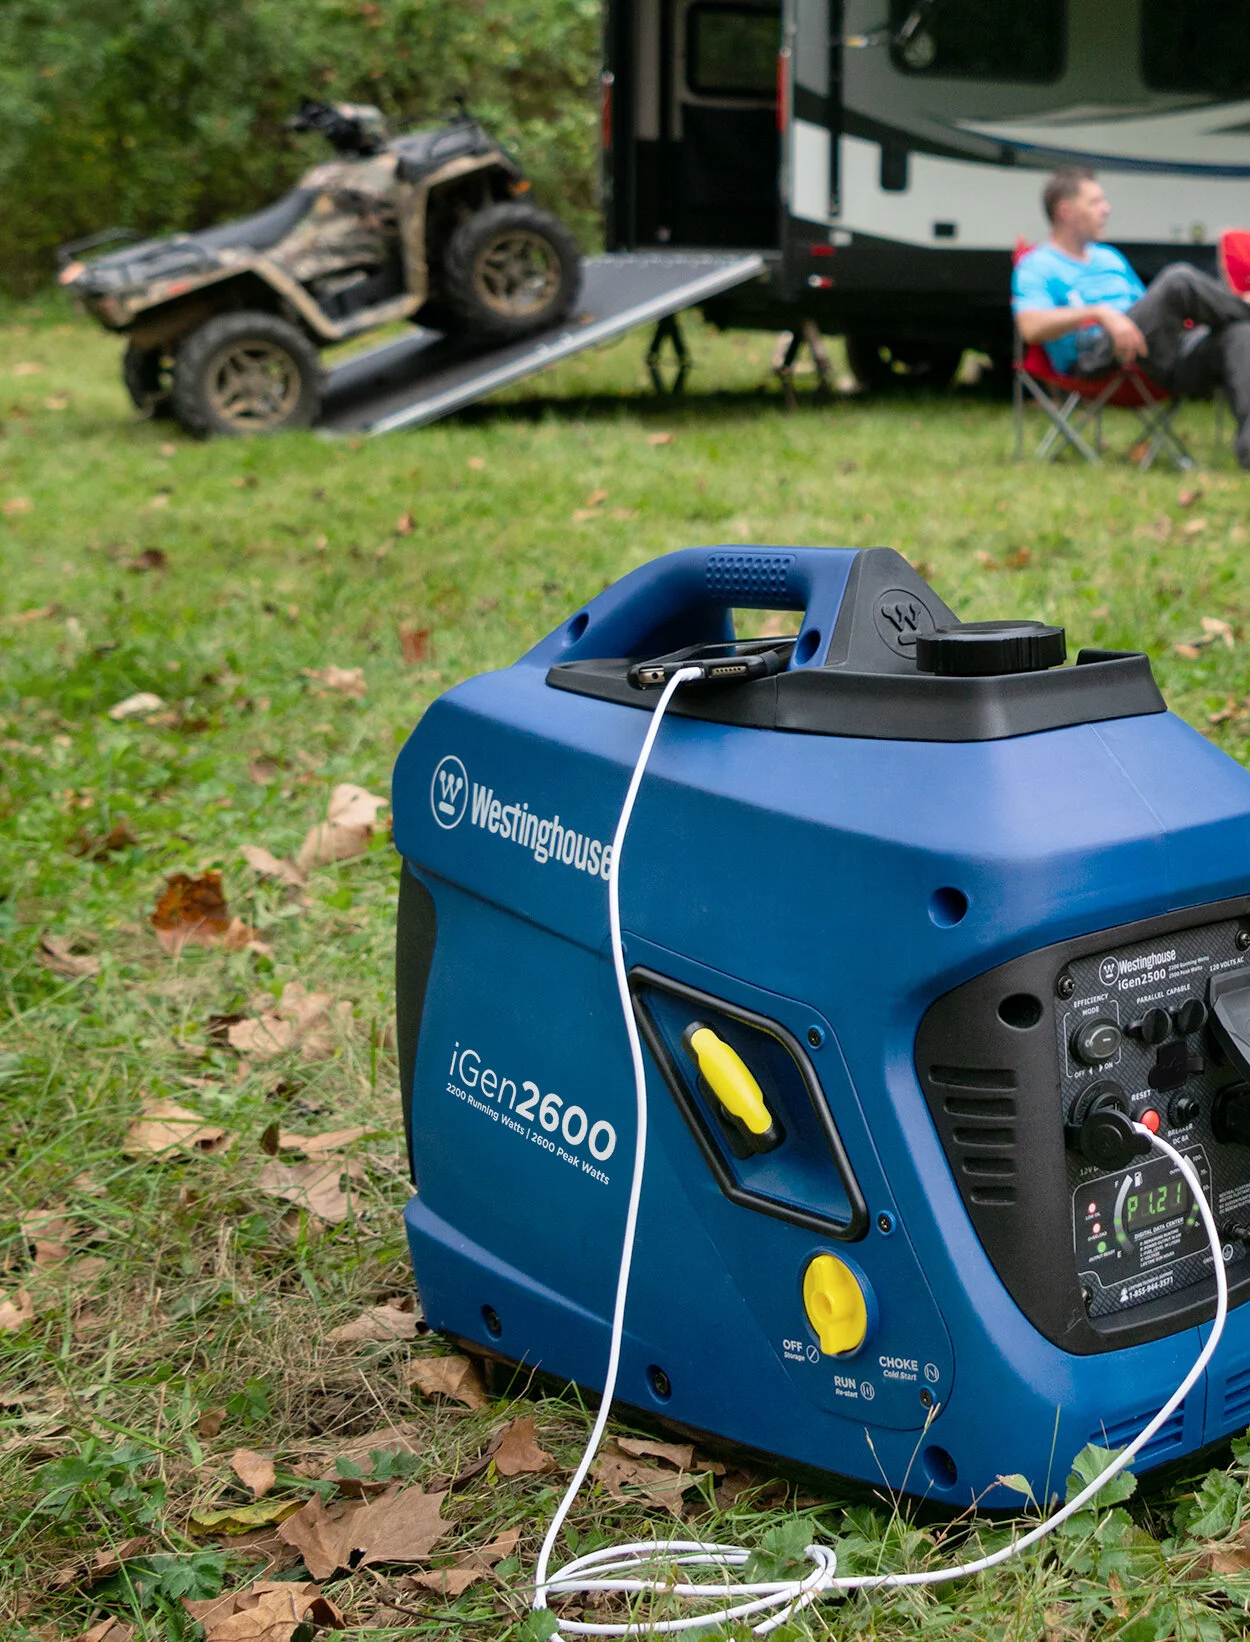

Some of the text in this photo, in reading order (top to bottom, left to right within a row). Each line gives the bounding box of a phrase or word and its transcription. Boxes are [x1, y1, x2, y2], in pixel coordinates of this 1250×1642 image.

[471, 782, 614, 881] Westinghouse
[1118, 949, 1177, 975] Westinghouse
[1209, 956, 1244, 972] 120 VOLTS AC
[1118, 969, 1166, 990] iGen2500
[1073, 993, 1109, 1008] EFFICIENCY
[1136, 983, 1191, 1004] PARALLEL CAPABLE
[1082, 1006, 1099, 1016] MODE
[1074, 1062, 1114, 1079] OFF ON
[449, 1041, 617, 1161] iGen2600
[1131, 1089, 1151, 1102] RESET
[446, 1083, 466, 1101] 2200
[467, 1094, 499, 1122] Running
[501, 1113, 525, 1136] Watts
[530, 1132, 555, 1153] 2600
[556, 1147, 579, 1168] Peak
[581, 1160, 610, 1186] Watts
[1114, 1180, 1119, 1188] F
[1134, 1216, 1184, 1240] DIGITAL DATA CENTER
[1117, 1250, 1122, 1258] E
[1129, 1275, 1174, 1300] 1-855-944-3571
[782, 1339, 802, 1352] OFF
[784, 1351, 806, 1363] Storage
[879, 1356, 919, 1372] CHOKE
[834, 1375, 856, 1389] RUN
[883, 1369, 917, 1381] Cold Start
[835, 1388, 859, 1399] Re-start
